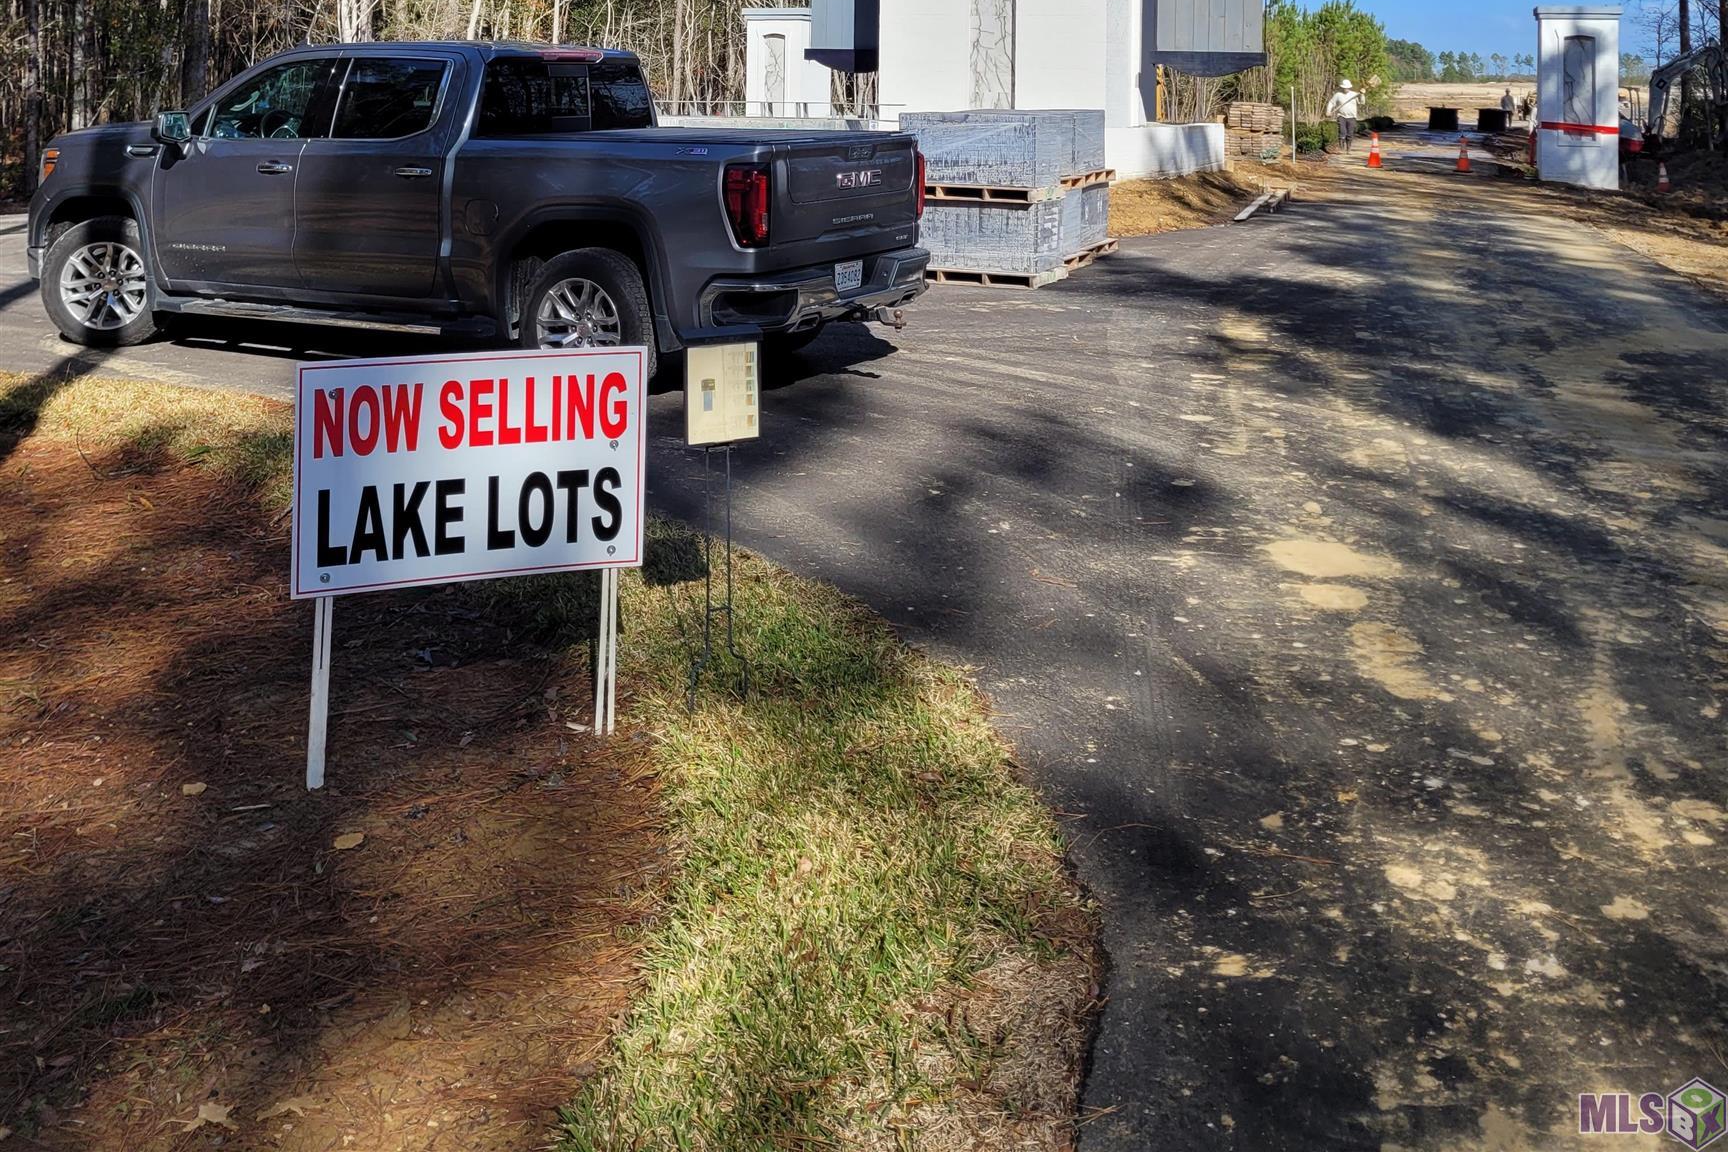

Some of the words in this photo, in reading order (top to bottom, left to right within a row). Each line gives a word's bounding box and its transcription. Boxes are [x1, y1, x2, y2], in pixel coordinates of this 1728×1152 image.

[836, 169, 882, 189] GMC
[313, 383, 424, 459] NOW
[438, 372, 628, 450] SELLING
[316, 478, 466, 568] LAKE
[487, 466, 623, 551] LOTS
